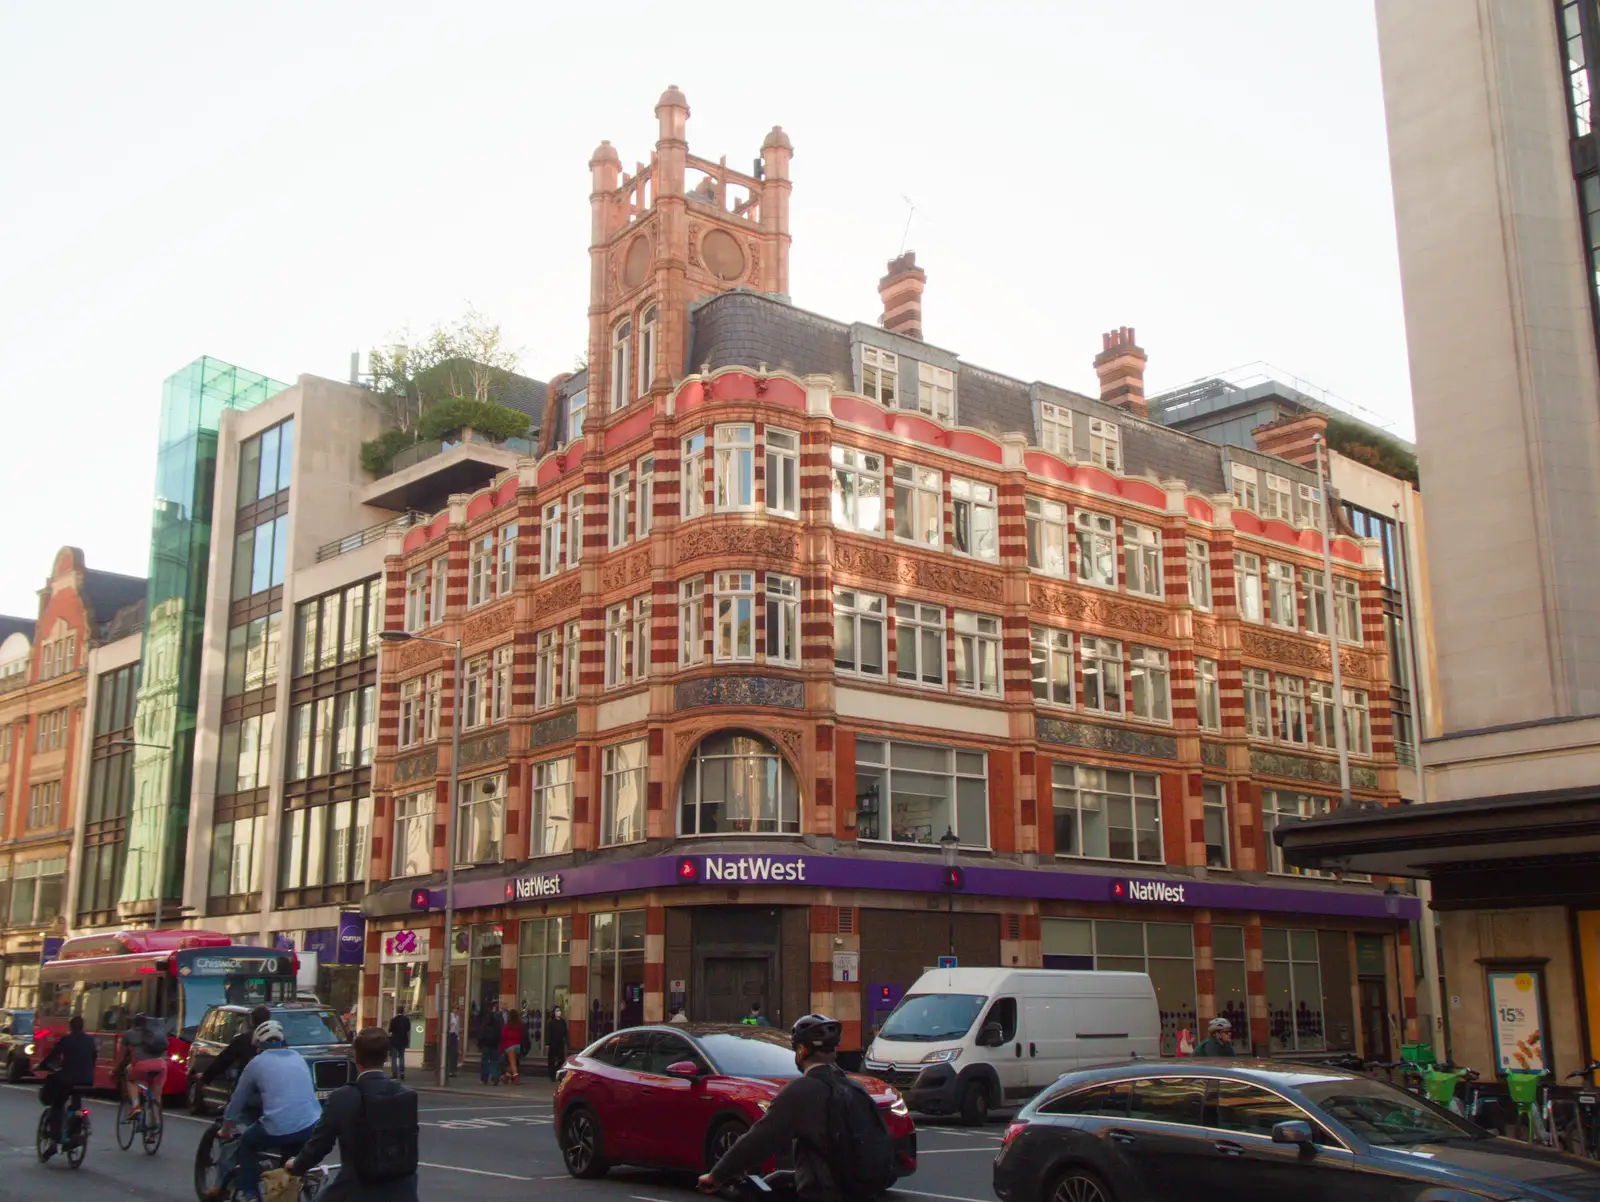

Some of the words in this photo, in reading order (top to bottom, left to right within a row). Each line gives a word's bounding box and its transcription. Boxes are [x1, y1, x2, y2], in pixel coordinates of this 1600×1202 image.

[706, 858, 805, 880] NatWest
[517, 874, 560, 898] NatWest
[1129, 881, 1185, 902] NatWest
[341, 935, 362, 943] currys
[196, 958, 242, 968] Chiswick
[258, 957, 278, 972] 70
